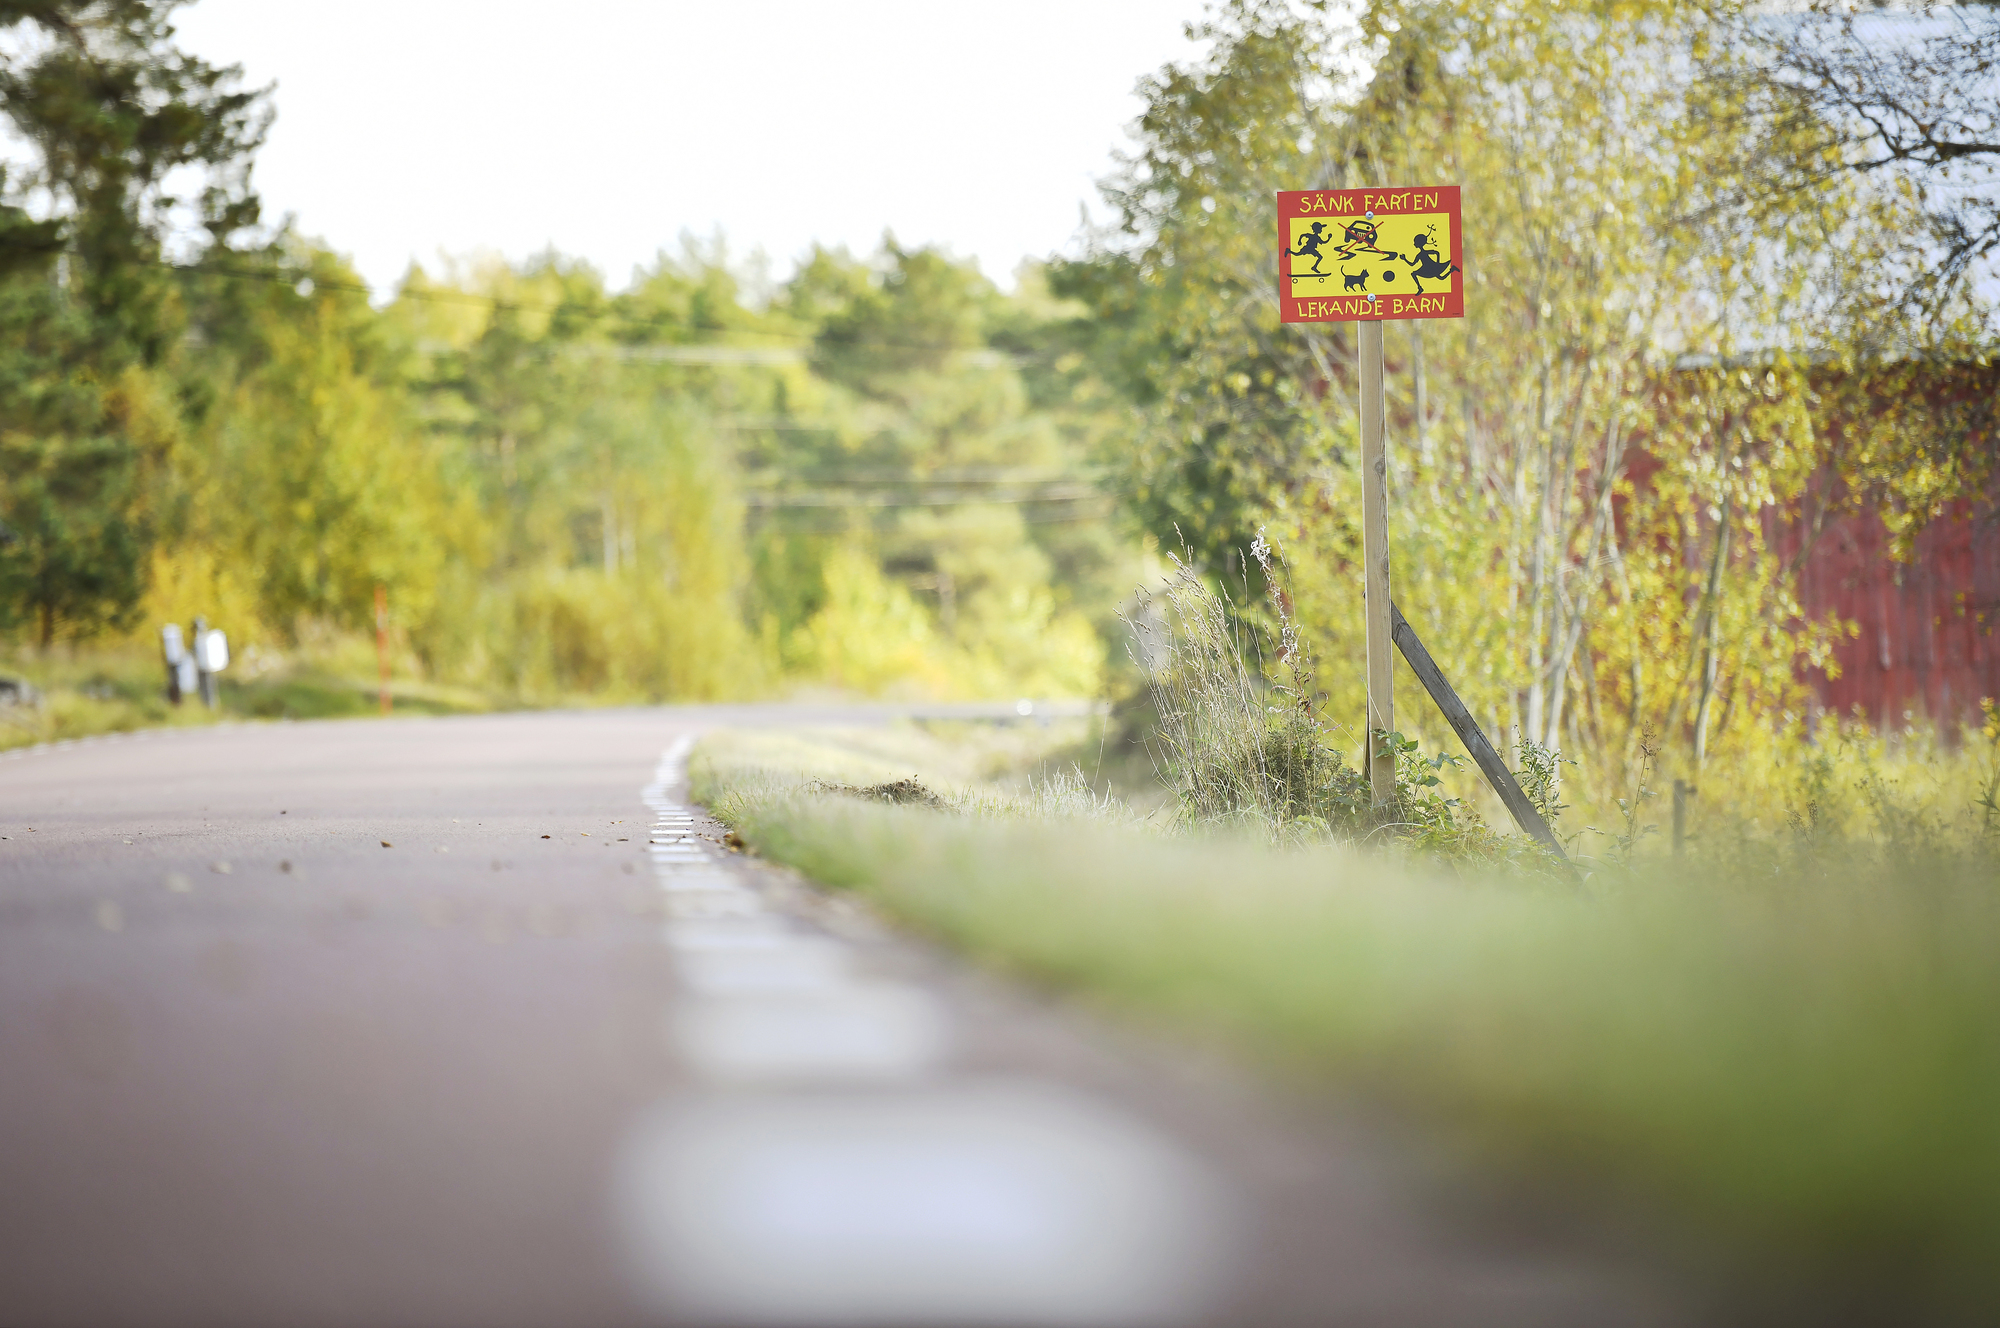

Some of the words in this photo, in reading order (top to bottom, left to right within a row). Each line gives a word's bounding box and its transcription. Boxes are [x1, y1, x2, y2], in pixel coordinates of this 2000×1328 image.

[1299, 194, 1355, 213] SÄNK
[1364, 192, 1438, 212] FARTEN
[1297, 299, 1384, 318] LEKANDE
[1393, 296, 1445, 314] BARN
